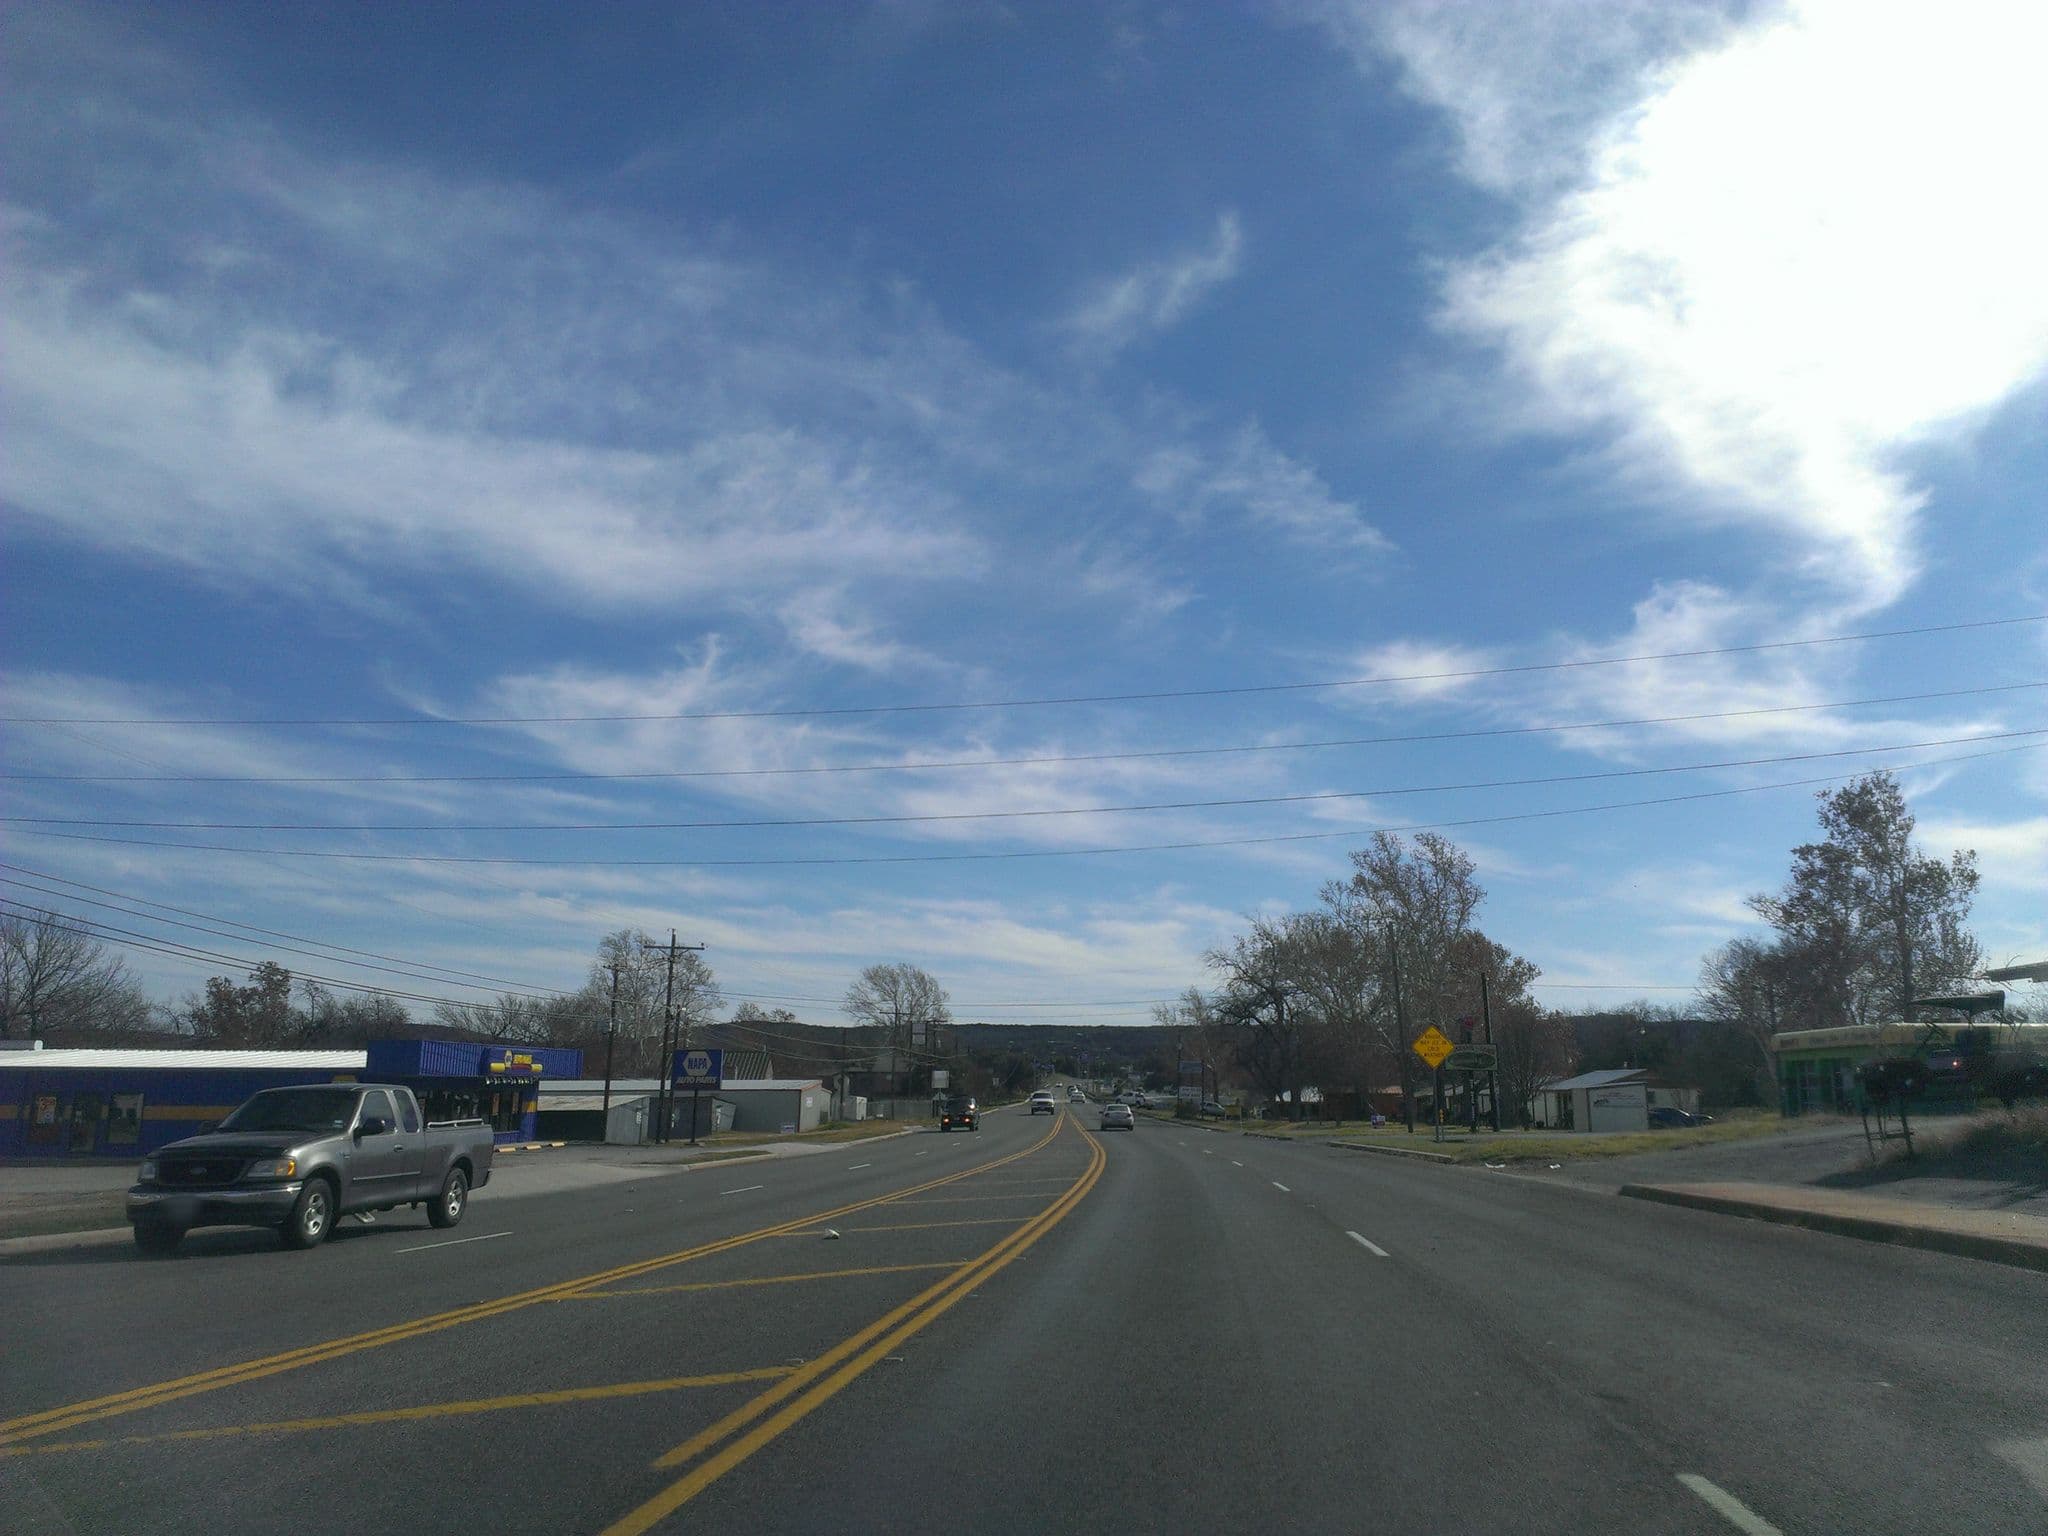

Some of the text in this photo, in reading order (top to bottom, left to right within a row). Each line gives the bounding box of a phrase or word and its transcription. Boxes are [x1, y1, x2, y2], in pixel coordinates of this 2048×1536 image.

[687, 1057, 707, 1069] NAPA
[675, 1076, 717, 1084] AUTO PARTS
